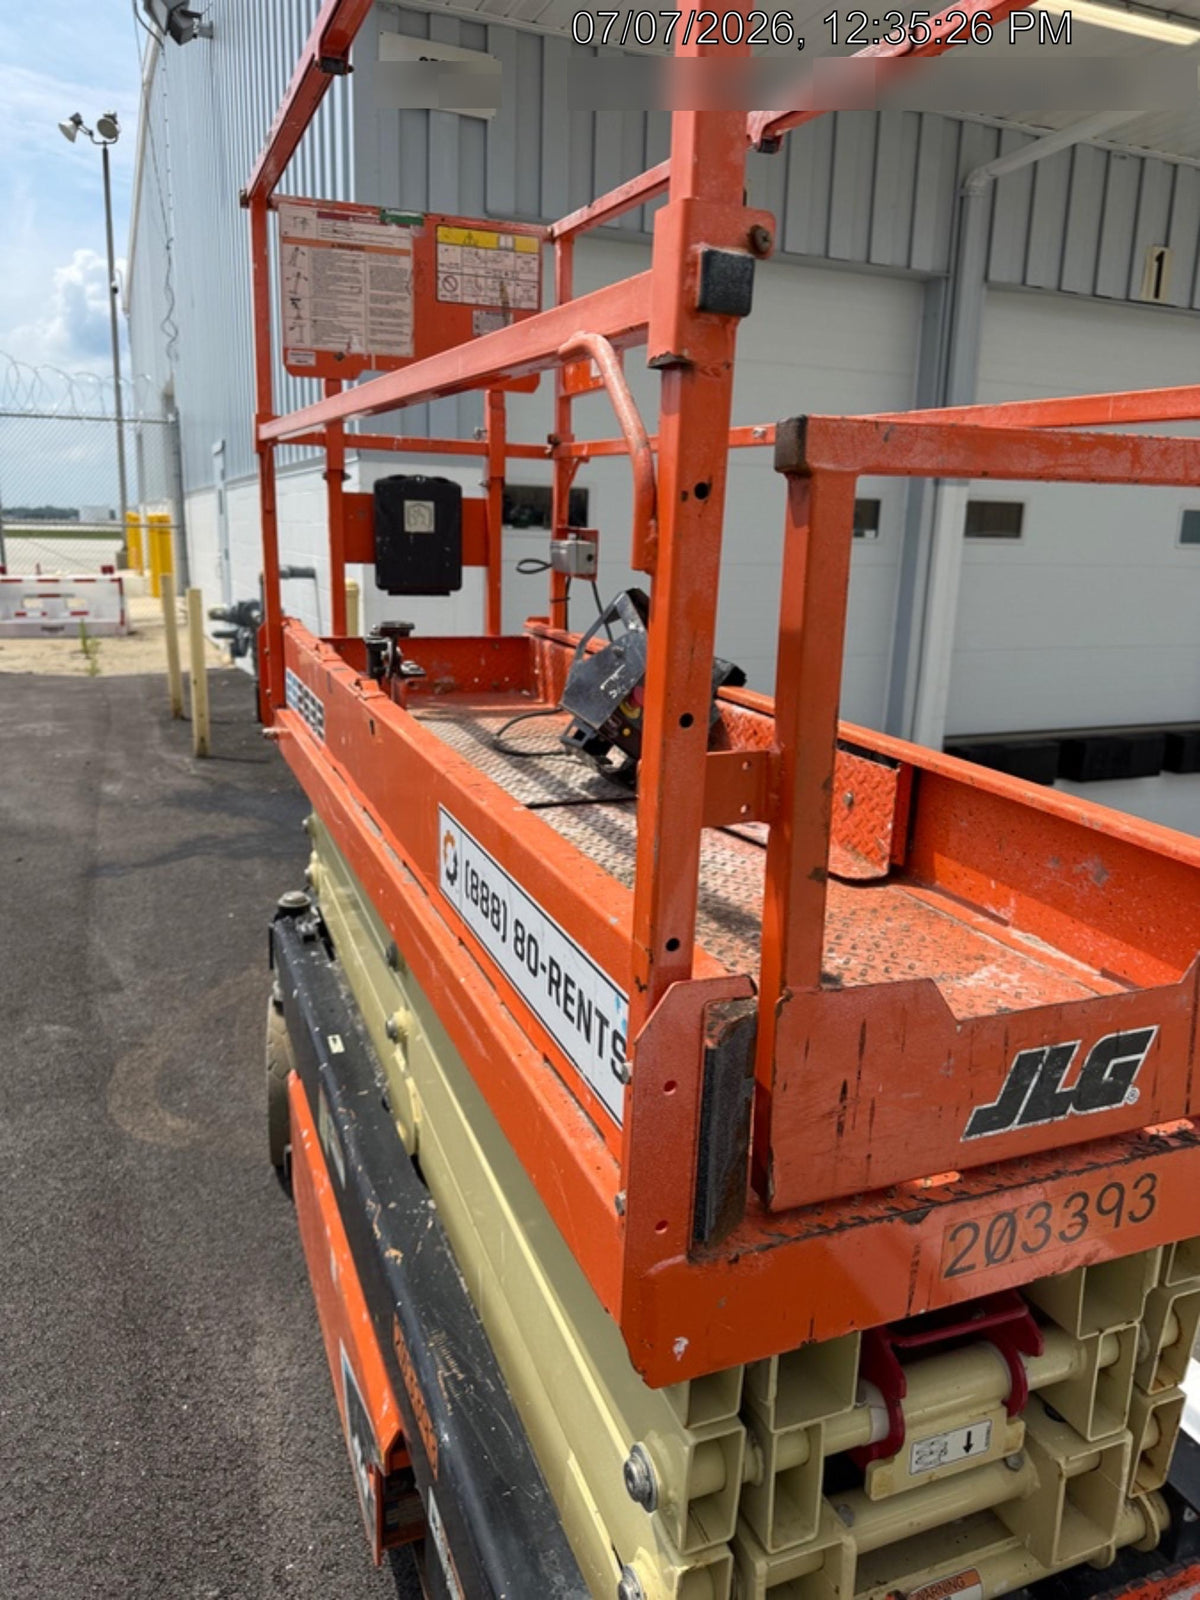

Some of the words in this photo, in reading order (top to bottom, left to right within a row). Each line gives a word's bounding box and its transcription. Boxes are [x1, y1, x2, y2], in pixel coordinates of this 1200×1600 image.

[1154, 249, 1166, 300] 1
[465, 859, 508, 943] (888)
[514, 917, 628, 1085] 80-RENTS
[942, 1172, 1158, 1280] 203393
